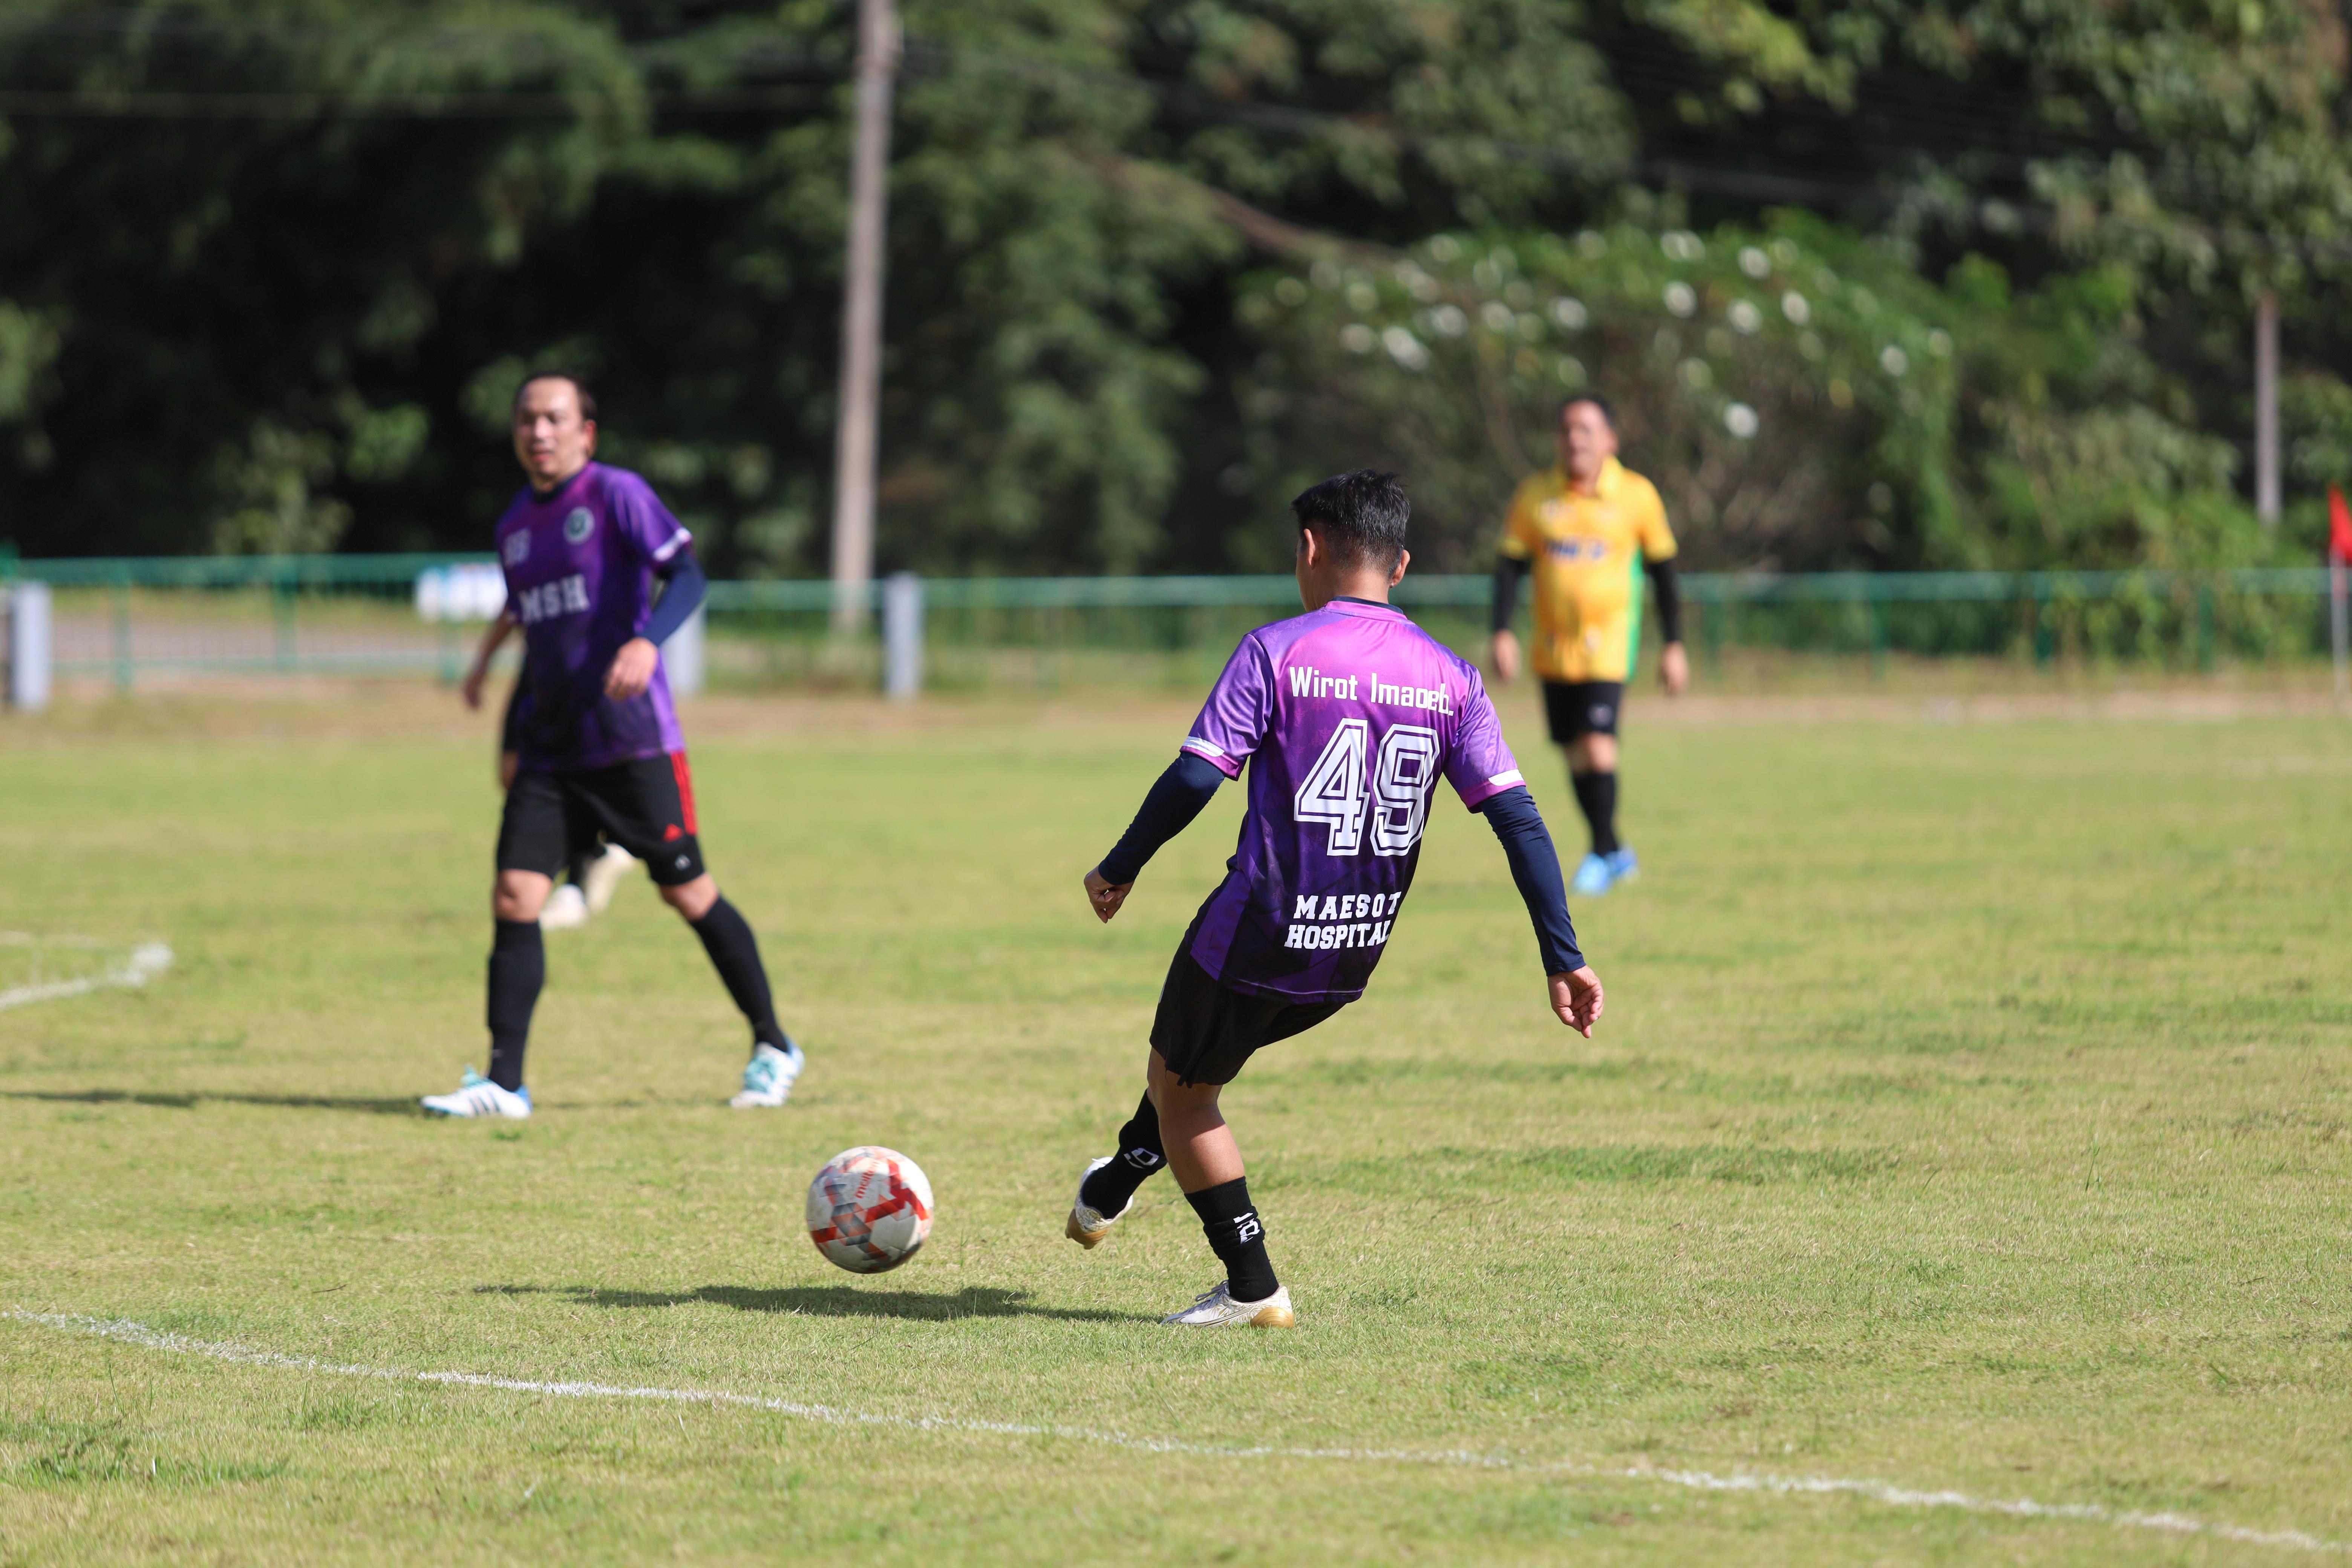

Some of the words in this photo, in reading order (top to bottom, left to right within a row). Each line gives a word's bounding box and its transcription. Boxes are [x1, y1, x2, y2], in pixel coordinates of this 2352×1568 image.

[1289, 666, 1358, 701] Wirot
[1294, 718, 1440, 856] 49
[1294, 891, 1402, 920] MAESOT
[1284, 920, 1391, 949] HOSPITAL
